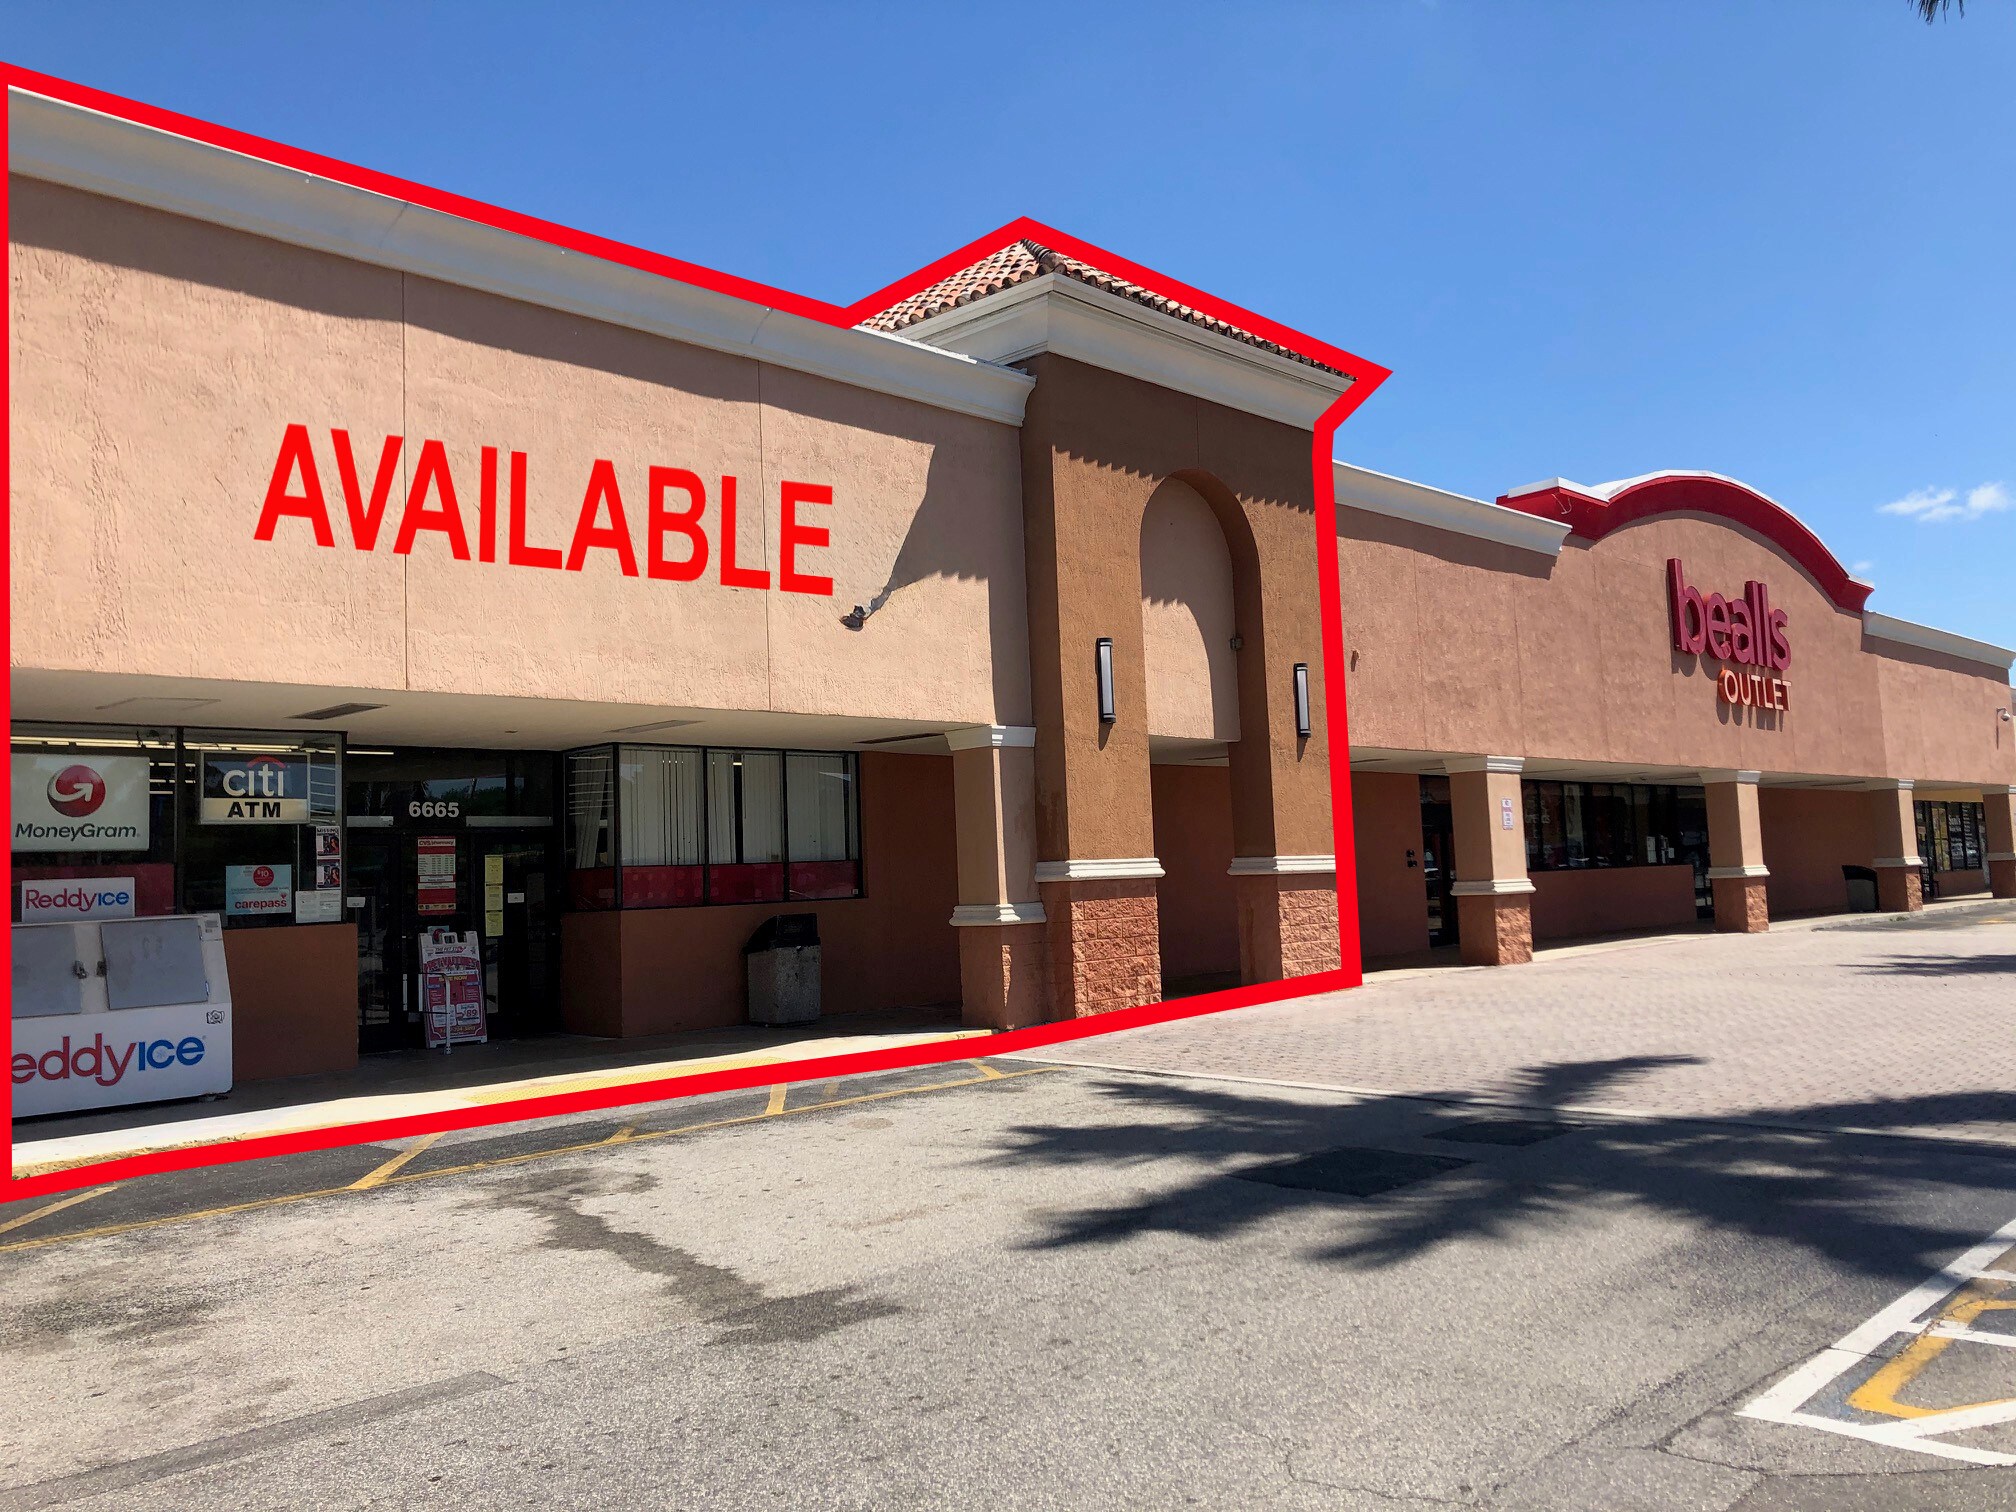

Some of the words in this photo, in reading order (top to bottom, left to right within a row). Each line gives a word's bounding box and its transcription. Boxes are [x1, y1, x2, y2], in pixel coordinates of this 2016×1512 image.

[1667, 558, 1792, 671] bealls
[1717, 669, 1792, 711] OUTLET
[222, 763, 284, 797] citi
[227, 801, 281, 818] ATM
[408, 801, 460, 818] 6665
[15, 823, 137, 842] MoneyGram
[235, 899, 287, 910] carepass
